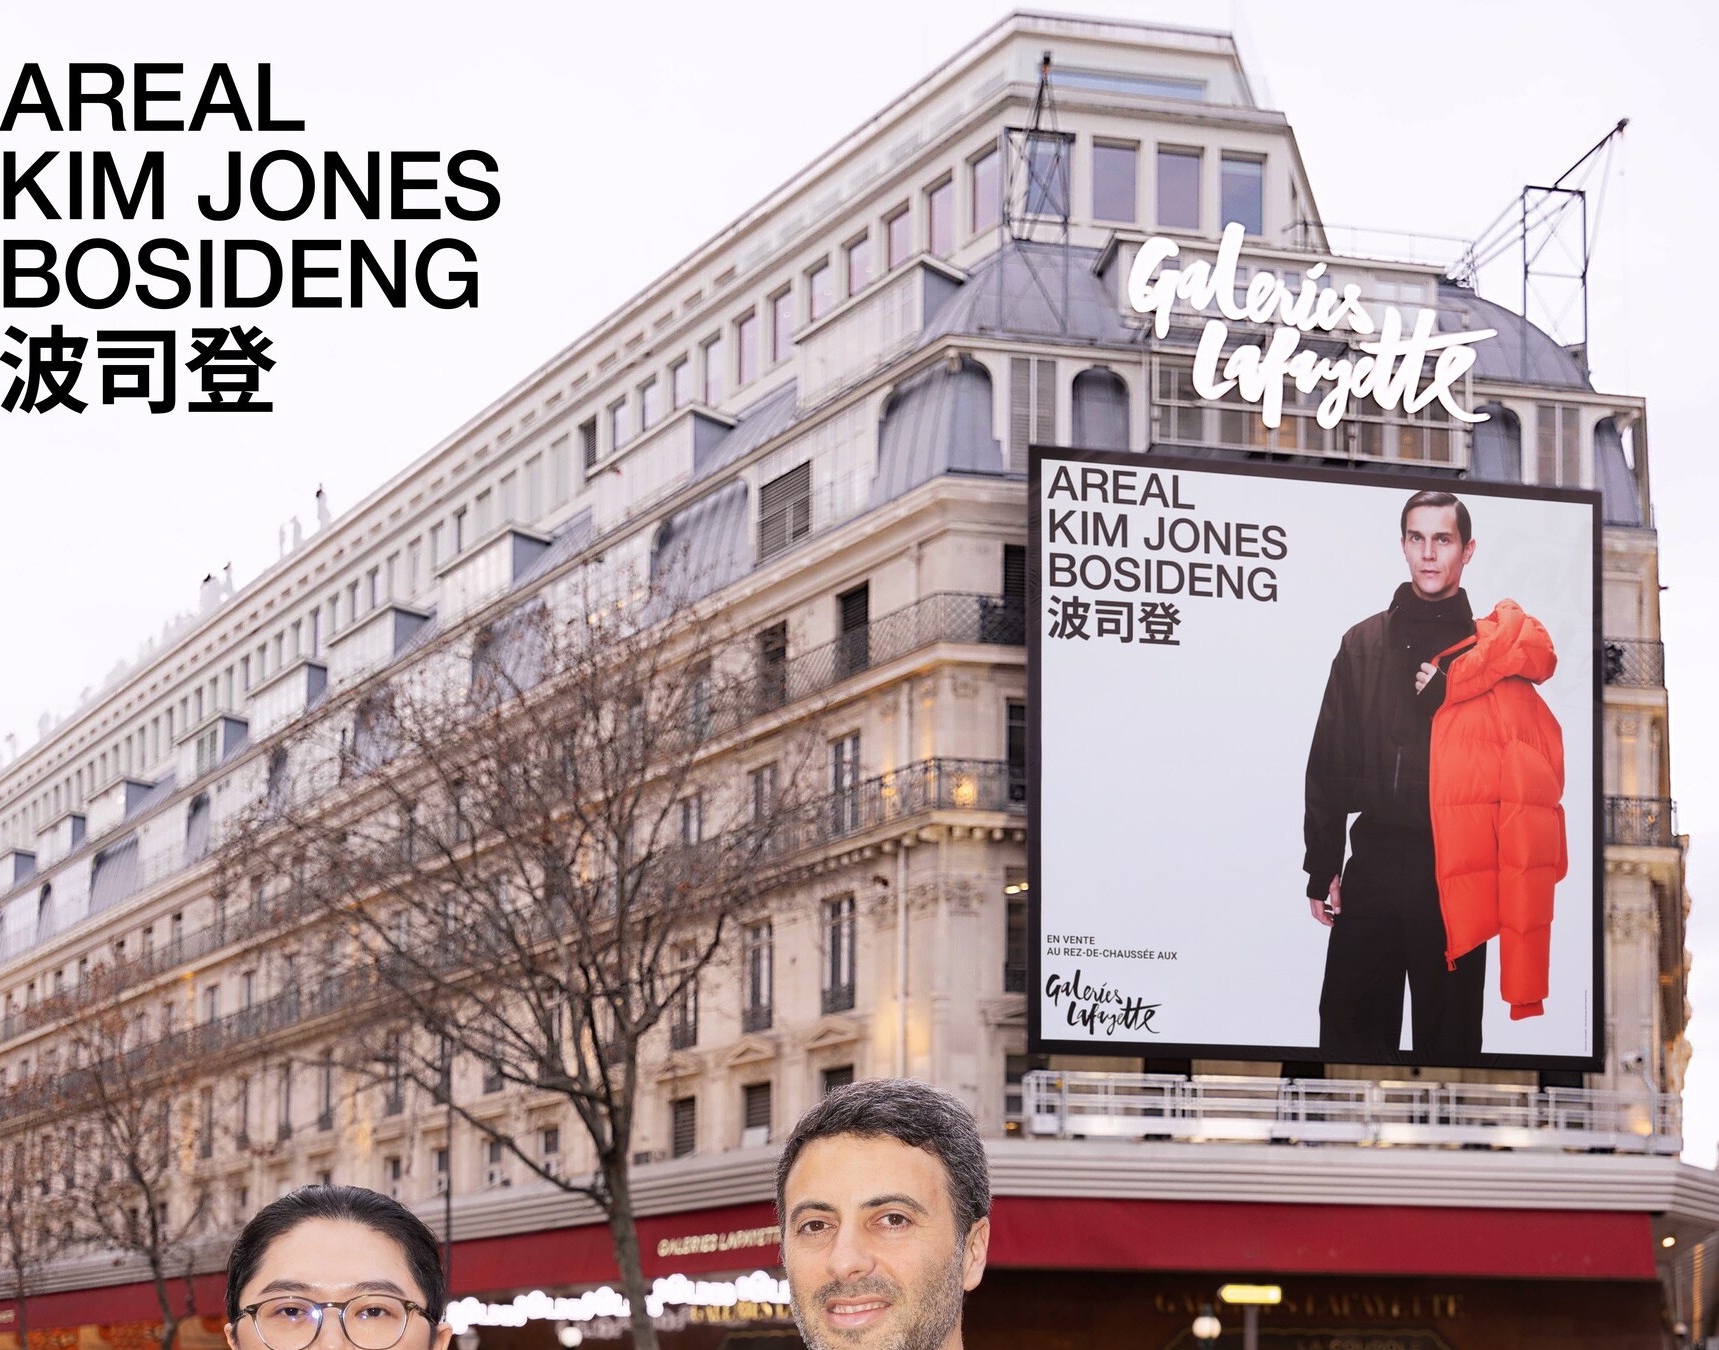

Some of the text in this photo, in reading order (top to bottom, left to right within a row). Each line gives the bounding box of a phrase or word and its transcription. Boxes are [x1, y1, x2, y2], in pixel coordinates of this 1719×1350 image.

[1128, 221, 1375, 339] Galeries
[1192, 305, 1498, 429] Lafayette
[1047, 465, 1196, 511] AREAL
[1048, 508, 1288, 561] KIM JONES
[1049, 552, 1278, 603] BOSIDENG
[1047, 595, 1182, 646] 波司登
[1046, 947, 1178, 961] AU REZ-DE-CHAUSSÉE AUX
[1047, 934, 1096, 945] EN VENTE
[1045, 969, 1124, 1007] Galeries
[1066, 996, 1162, 1036] Lafayette
[657, 1233, 719, 1257] GALERIES
